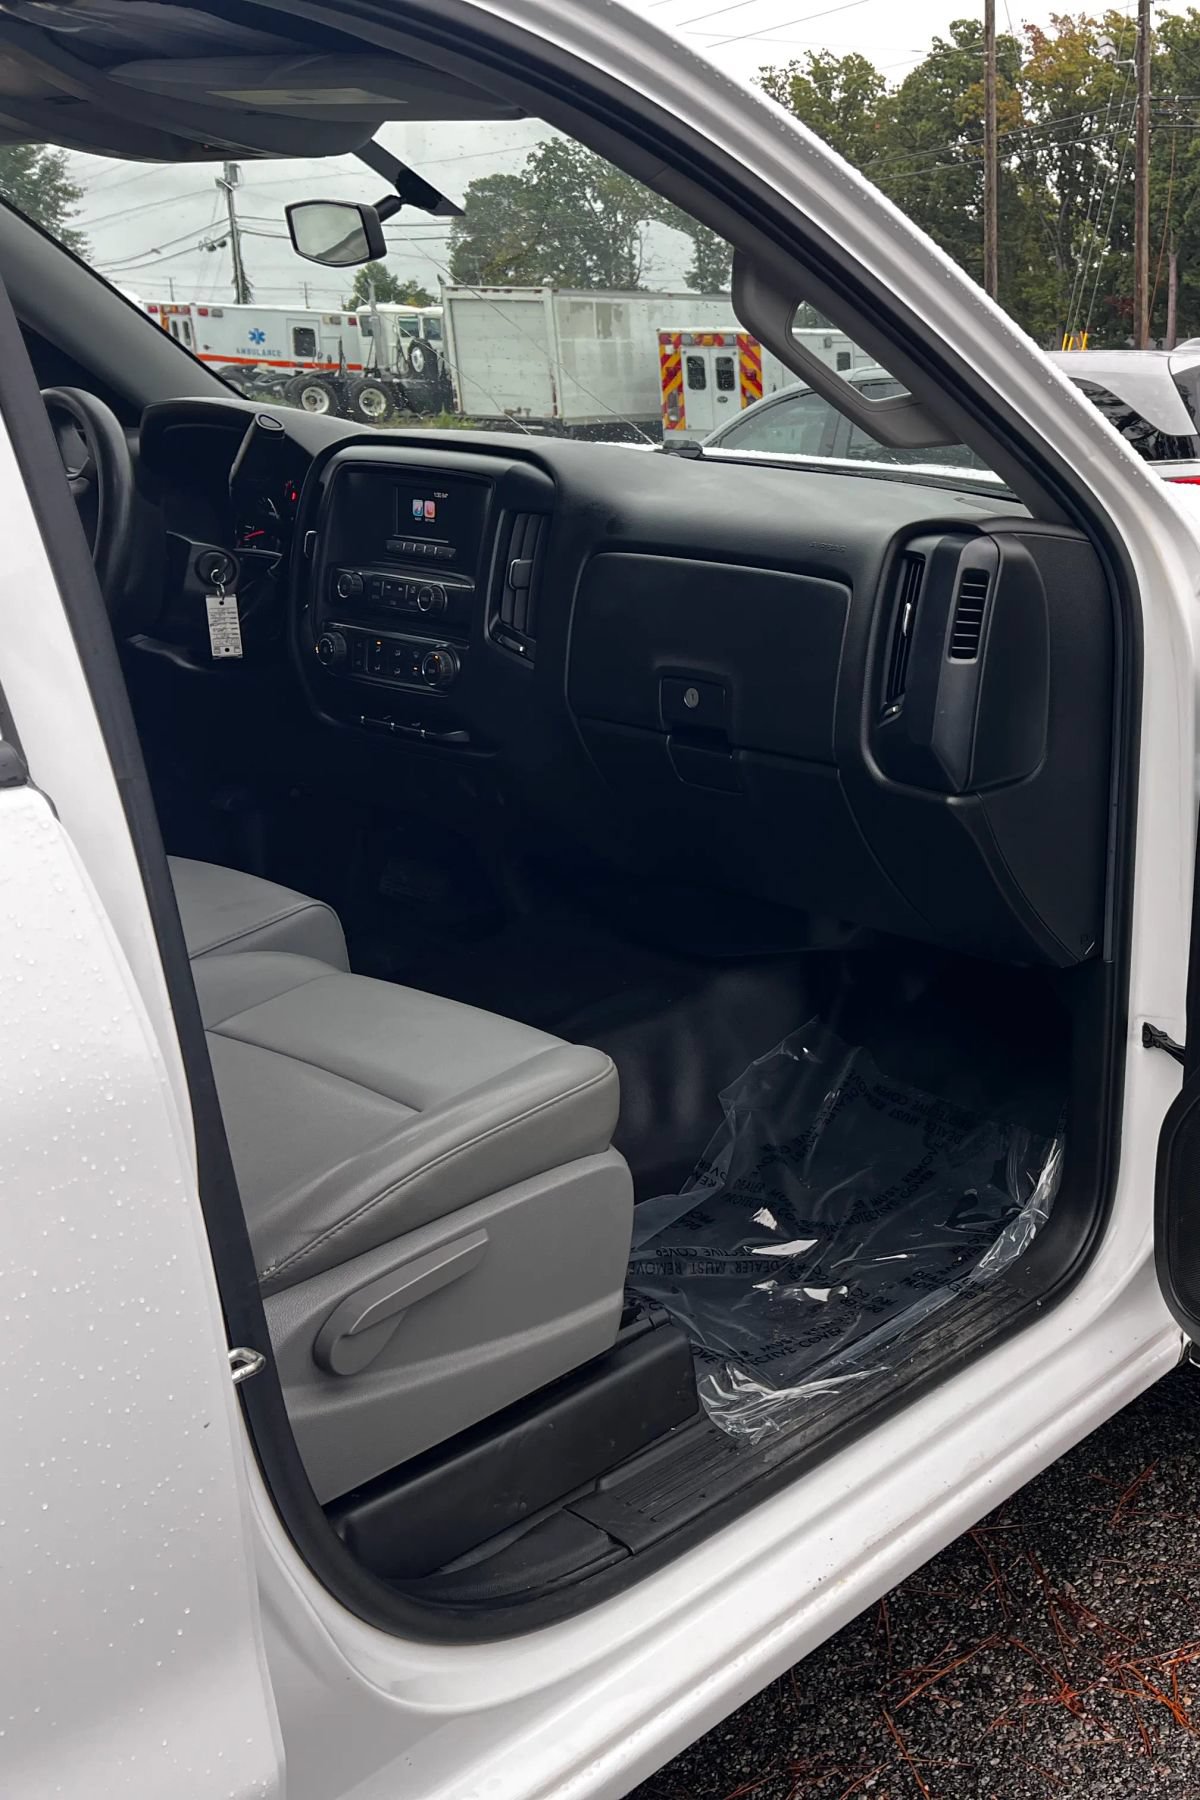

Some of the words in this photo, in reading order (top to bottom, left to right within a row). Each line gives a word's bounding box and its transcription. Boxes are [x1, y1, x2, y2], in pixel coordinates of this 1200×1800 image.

[236, 347, 281, 357] AMBULANCE
[629, 1262, 682, 1276] REMOVE
[688, 1262, 726, 1275] MUST
[735, 1260, 781, 1274] DEALER
[799, 1325, 843, 1348] COVER
